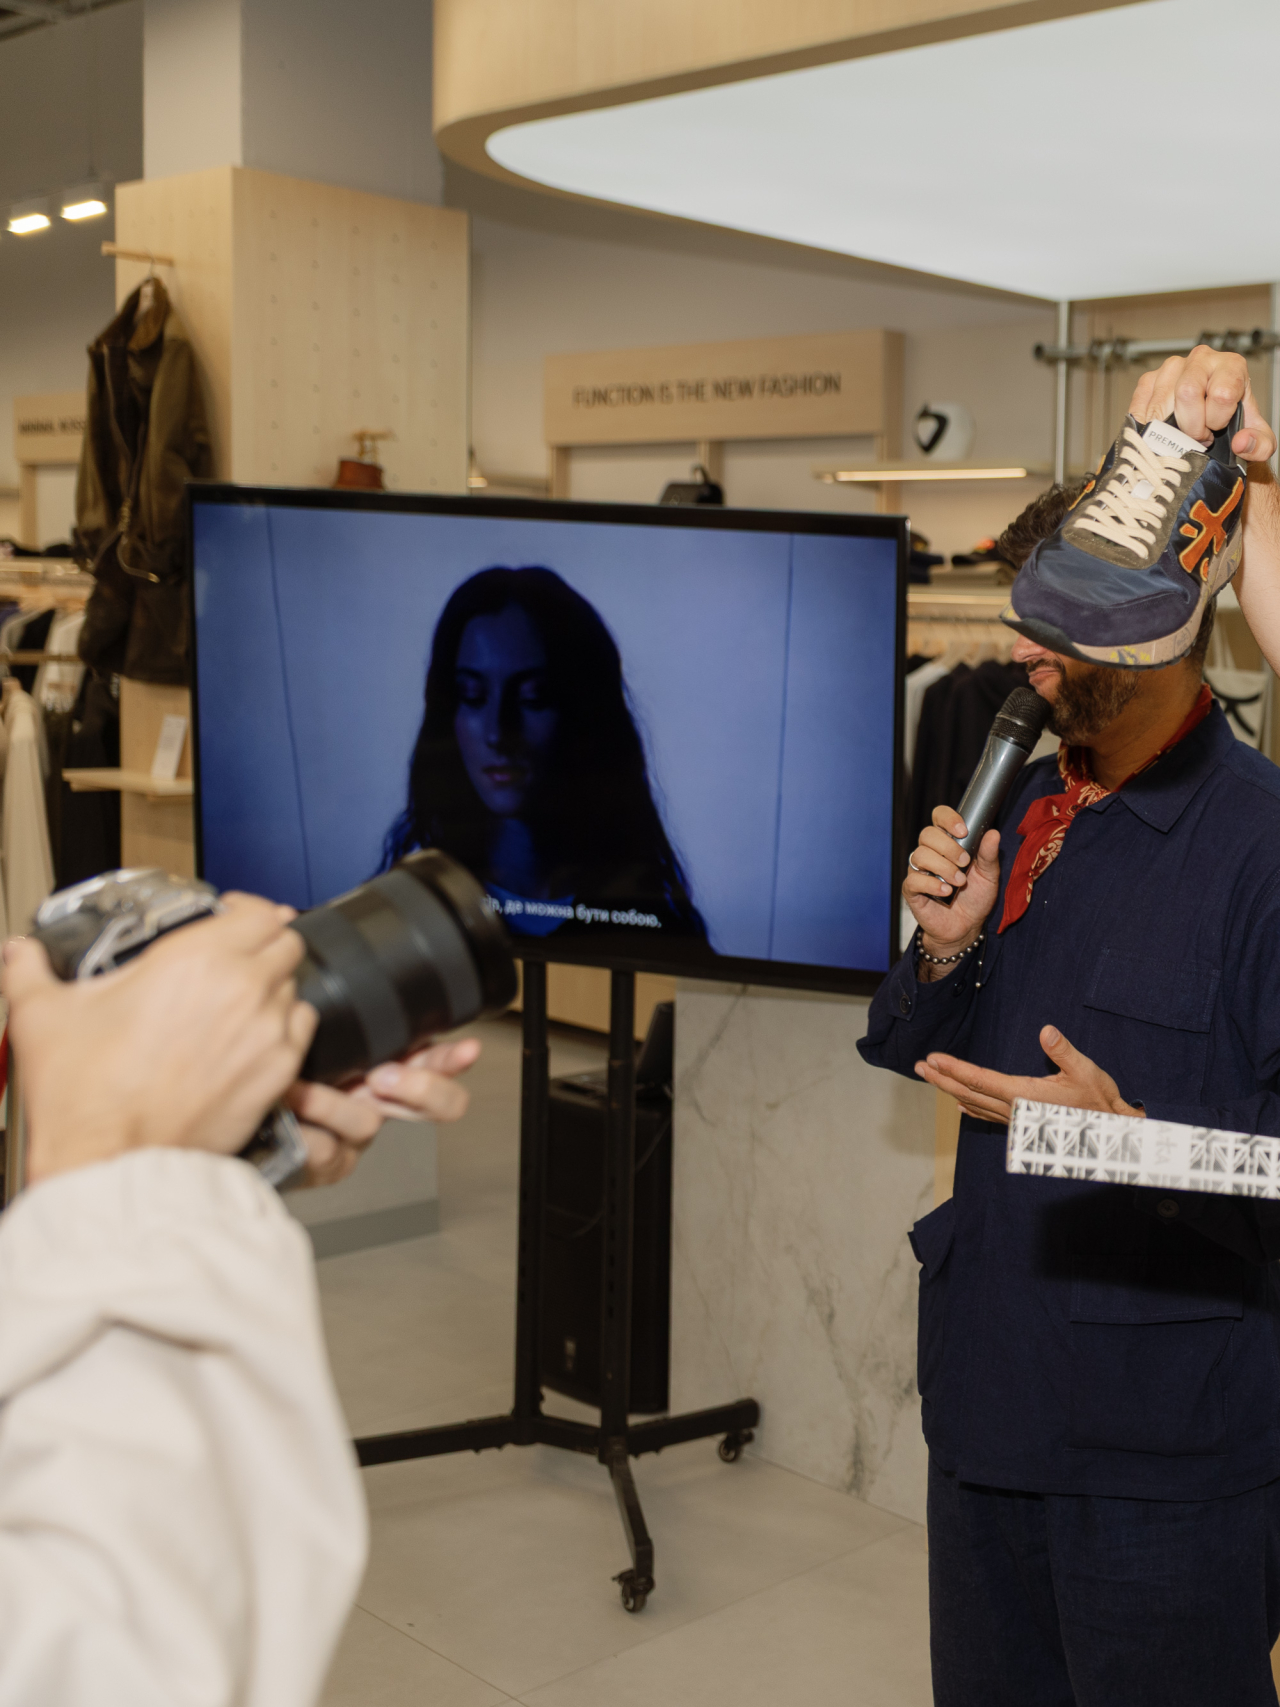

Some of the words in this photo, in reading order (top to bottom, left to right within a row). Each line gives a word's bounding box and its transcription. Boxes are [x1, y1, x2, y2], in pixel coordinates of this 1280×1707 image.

[572, 382, 655, 409] FUNCTION
[660, 380, 674, 405] IS
[676, 378, 708, 403] THE
[711, 375, 756, 400] NEW
[759, 371, 841, 397] FASHION
[1149, 430, 1187, 456] PREMIA
[504, 899, 523, 915] де
[525, 901, 574, 918] можна
[575, 903, 609, 923] бути
